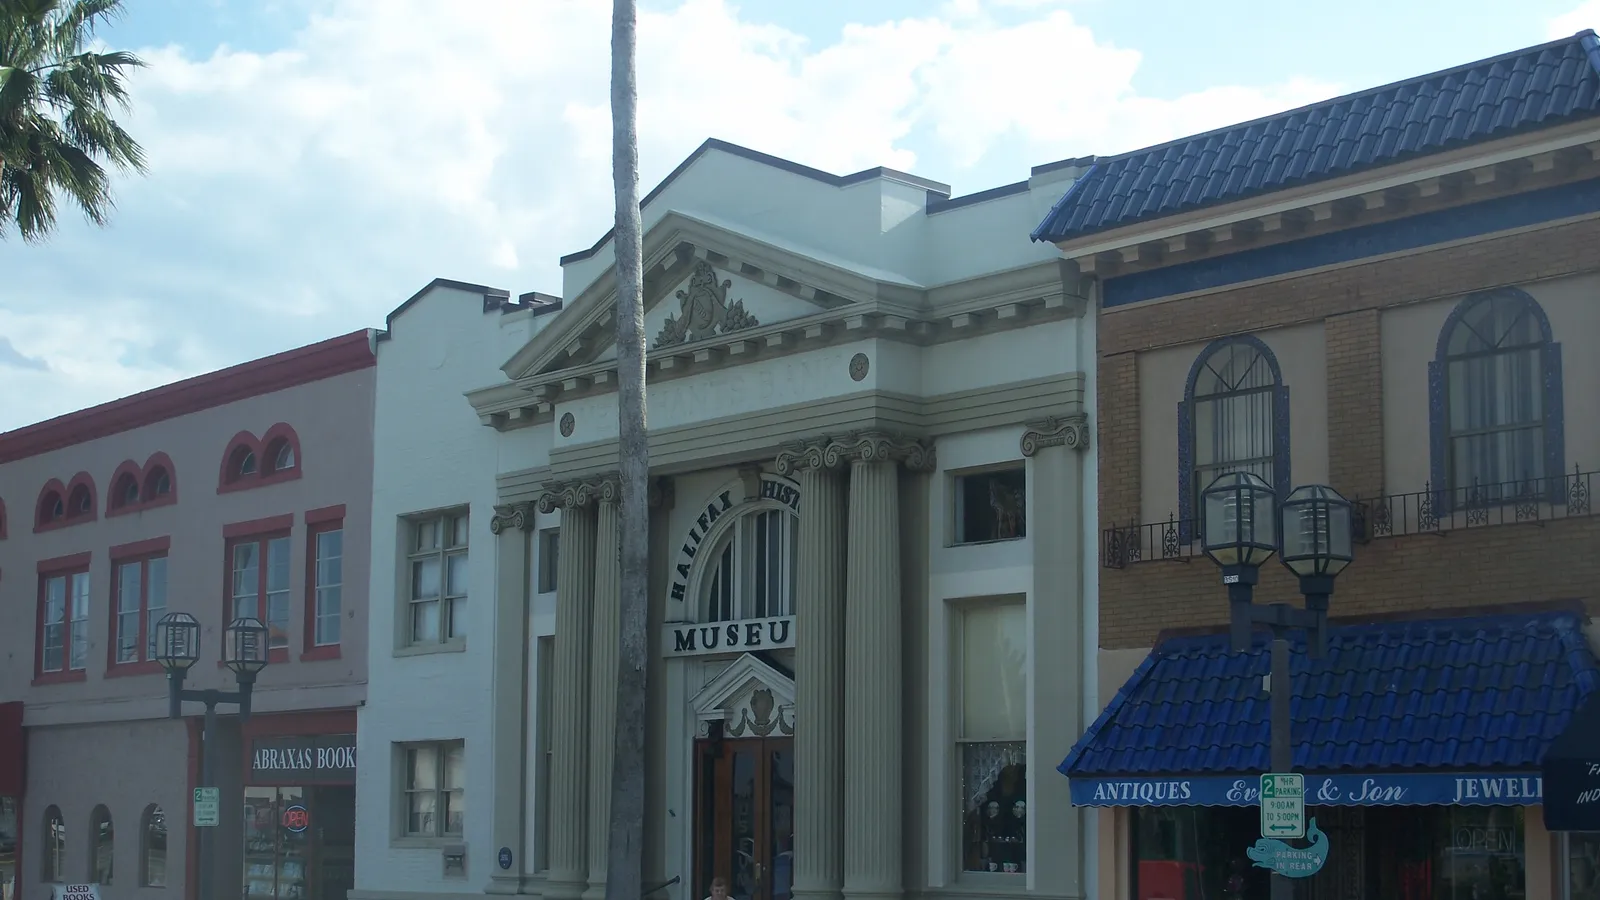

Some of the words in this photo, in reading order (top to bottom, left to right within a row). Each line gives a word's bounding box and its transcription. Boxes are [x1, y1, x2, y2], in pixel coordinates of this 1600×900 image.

[671, 490, 733, 602] HALIFAX
[761, 480, 800, 514] HIST
[674, 620, 790, 651] MUSEU
[252, 748, 312, 770] ABRAXAS
[317, 746, 356, 769] BOOK
[1093, 781, 1191, 803] ANTIQUES
[1317, 778, 1341, 801] &
[1348, 778, 1408, 802] Son
[1263, 779, 1273, 795] 2
[1283, 777, 1294, 786] HR
[1276, 787, 1301, 796] PARKING
[195, 790, 202, 801] 2
[282, 810, 309, 828] OPEN
[1266, 813, 1274, 821] TO
[1456, 828, 1512, 850] OPEN
[1276, 851, 1313, 860] PARKING
[1276, 862, 1285, 870] IN
[1290, 862, 1312, 870] REAR
[66, 885, 89, 893] USED
